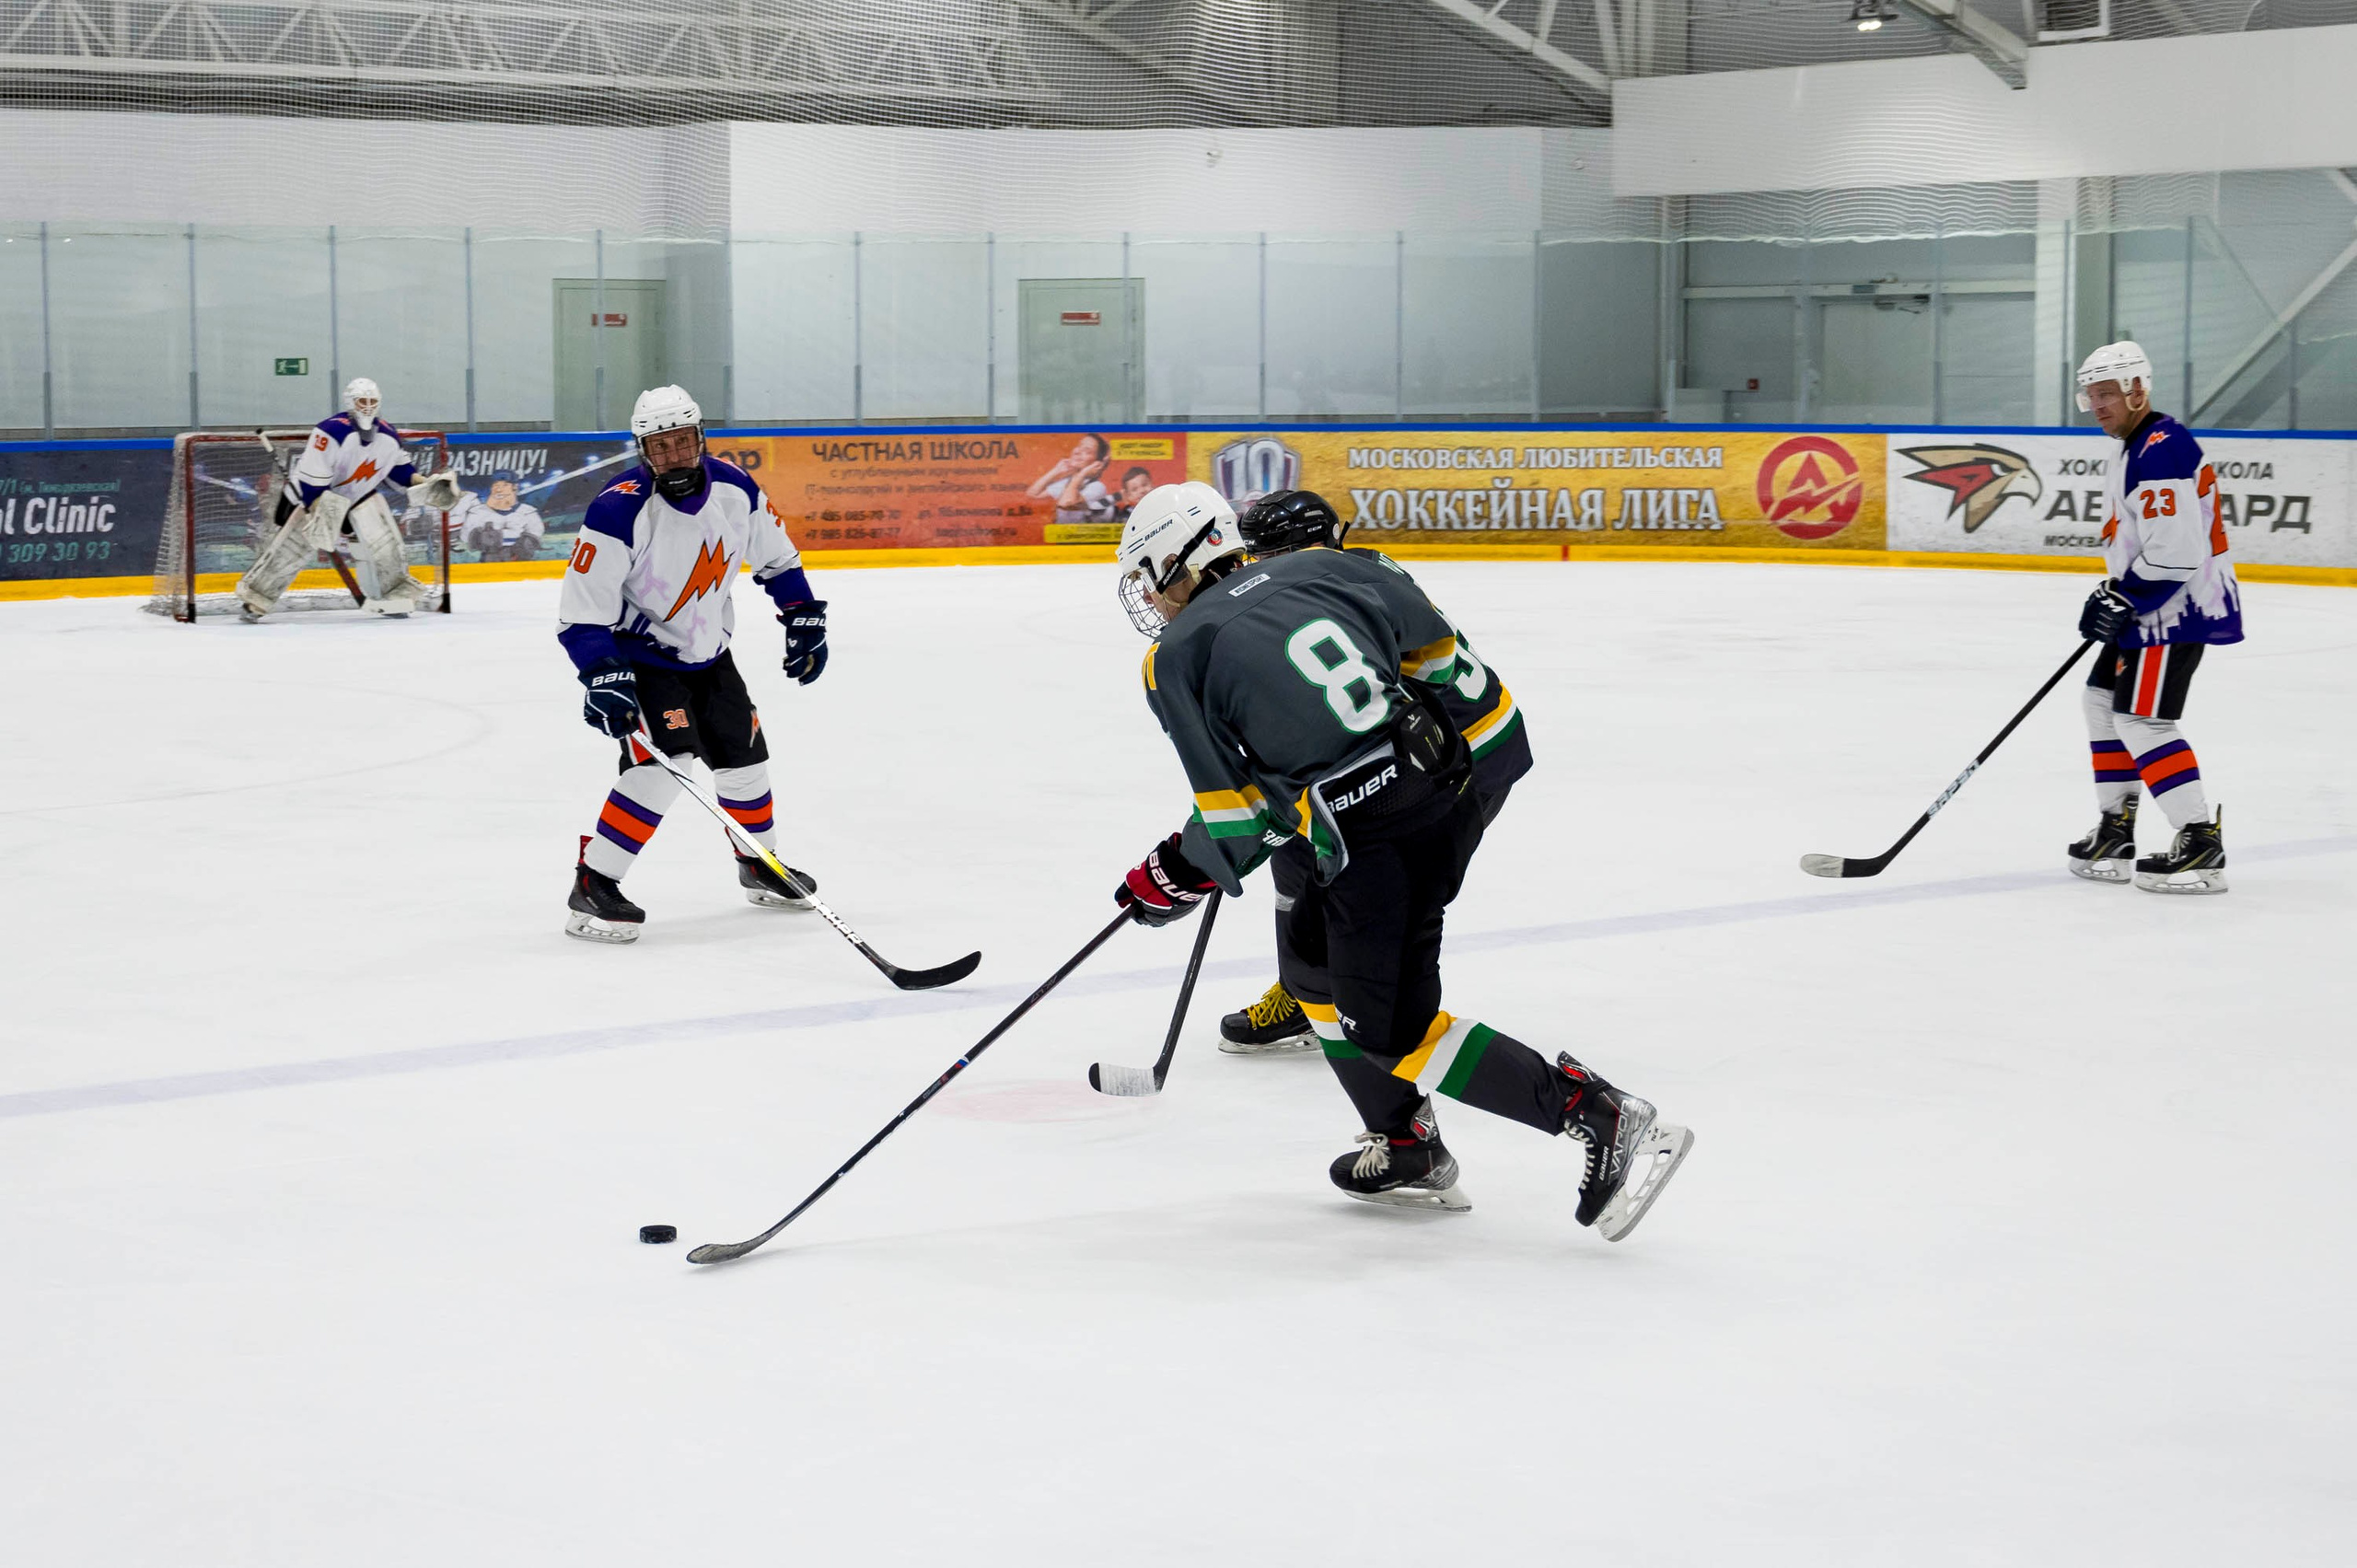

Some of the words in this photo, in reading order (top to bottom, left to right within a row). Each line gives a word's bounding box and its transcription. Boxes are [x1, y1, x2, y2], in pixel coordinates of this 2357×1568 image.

[812, 441, 923, 461] ЧАСТНАЯ
[930, 439, 1019, 460] ШКОЛА
[1348, 447, 1514, 469] МОСКОВСКАЯ
[1519, 447, 1723, 469] ЛЮБИТЕЛЬСКАЯ
[2212, 461, 2274, 480] КОЛА
[24, 495, 116, 534] Clinic
[1350, 477, 1605, 530] ХОККЕЙНАЯ
[1612, 488, 1724, 530] ЛИГА
[2140, 488, 2177, 519] 23
[1144, 518, 1173, 541] BAUER
[1307, 525, 1323, 533] CCM
[7, 543, 48, 563] 309
[52, 541, 80, 562] 30
[85, 540, 111, 560] 93
[1162, 562, 1179, 586] BAUER
[1285, 617, 1390, 735] 8
[663, 708, 690, 729] 30
[1609, 1099, 1631, 1175] VAPOR
[1598, 1145, 1609, 1181] BAUER
